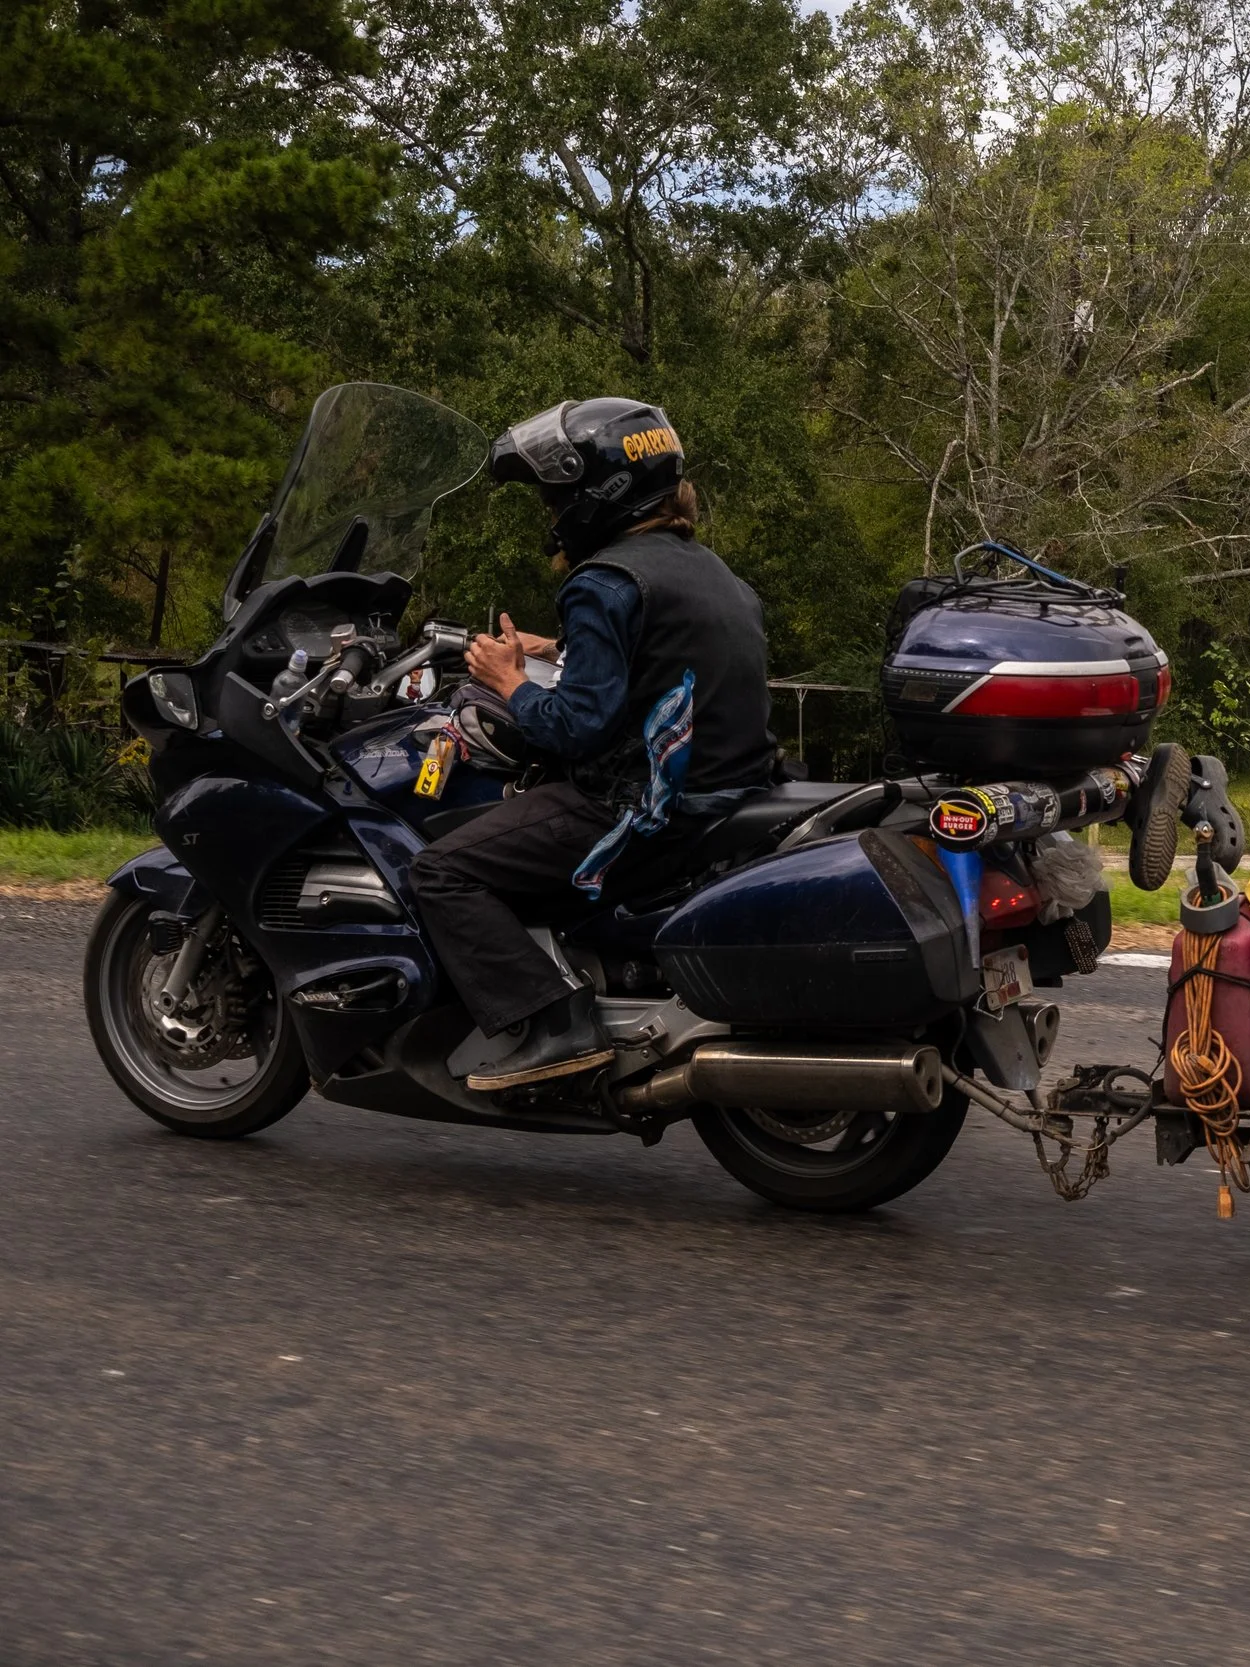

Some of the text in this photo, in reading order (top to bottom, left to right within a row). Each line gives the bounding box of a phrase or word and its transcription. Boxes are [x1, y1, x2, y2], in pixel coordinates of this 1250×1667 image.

[943, 815, 974, 823] IN-N-OUT
[943, 822, 974, 830] BURGER
[181, 833, 201, 846] ST
